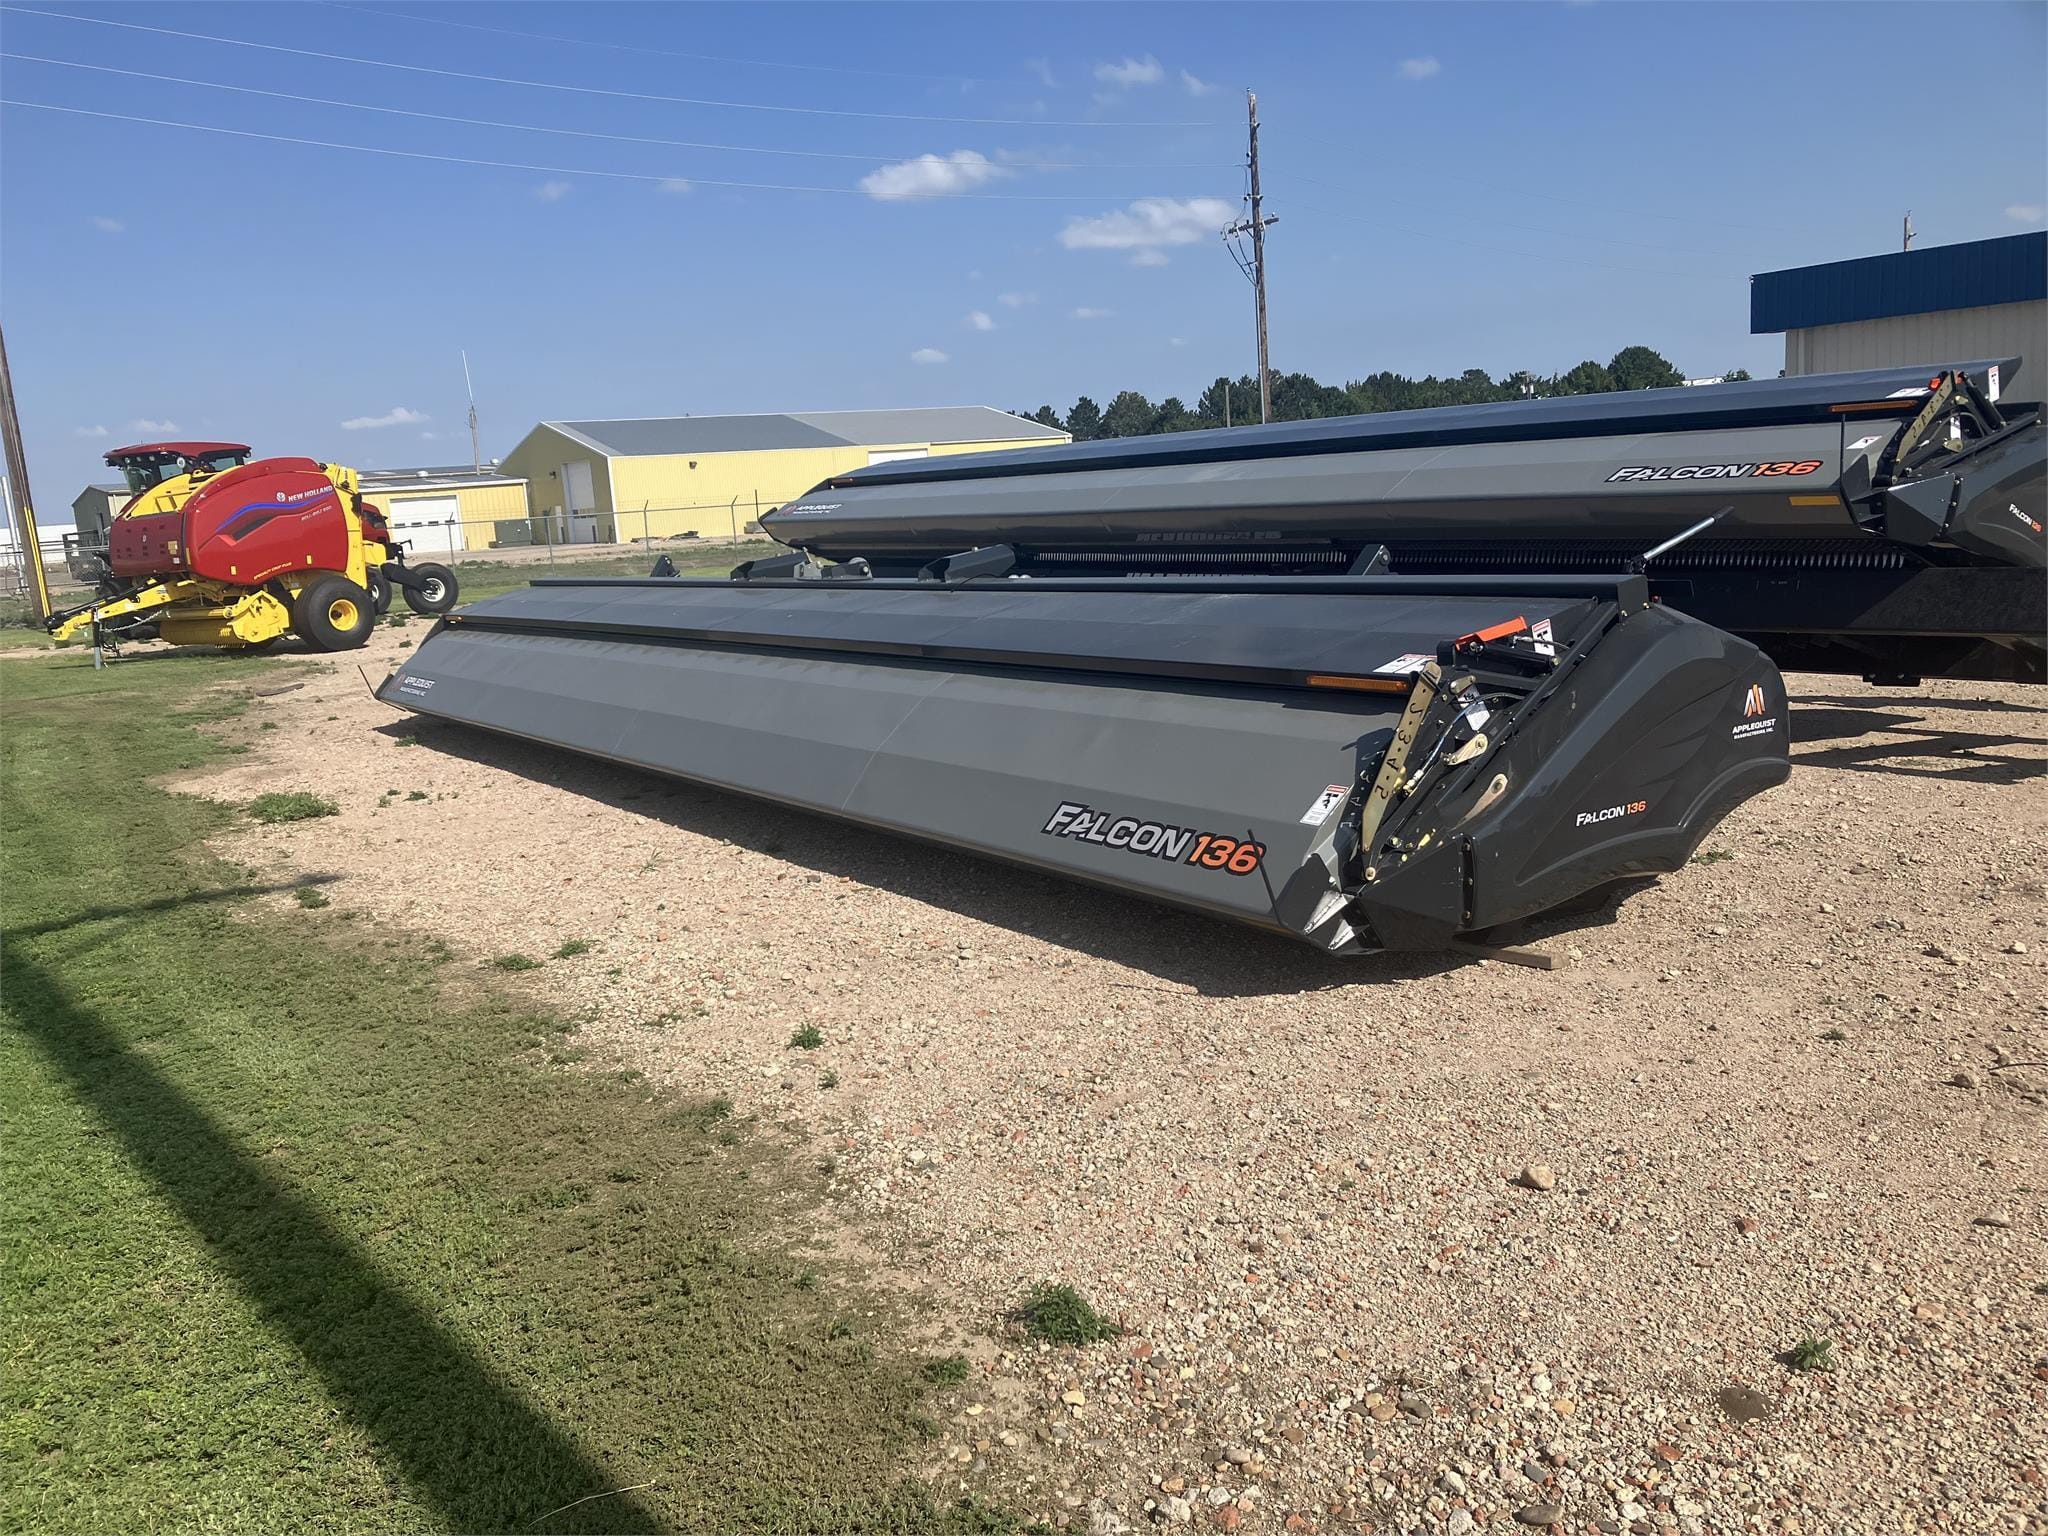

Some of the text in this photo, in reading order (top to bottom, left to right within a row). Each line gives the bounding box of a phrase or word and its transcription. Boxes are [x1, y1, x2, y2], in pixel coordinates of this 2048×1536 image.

[1606, 460, 1823, 483] FALCON 136
[288, 485, 333, 502] NEW HOLLAND
[2009, 503, 2033, 526] FALCON
[1732, 718, 1777, 734] APPLEQUIST
[1576, 800, 1647, 827] FALCON 136
[1042, 801, 1265, 876] FALCON 136
